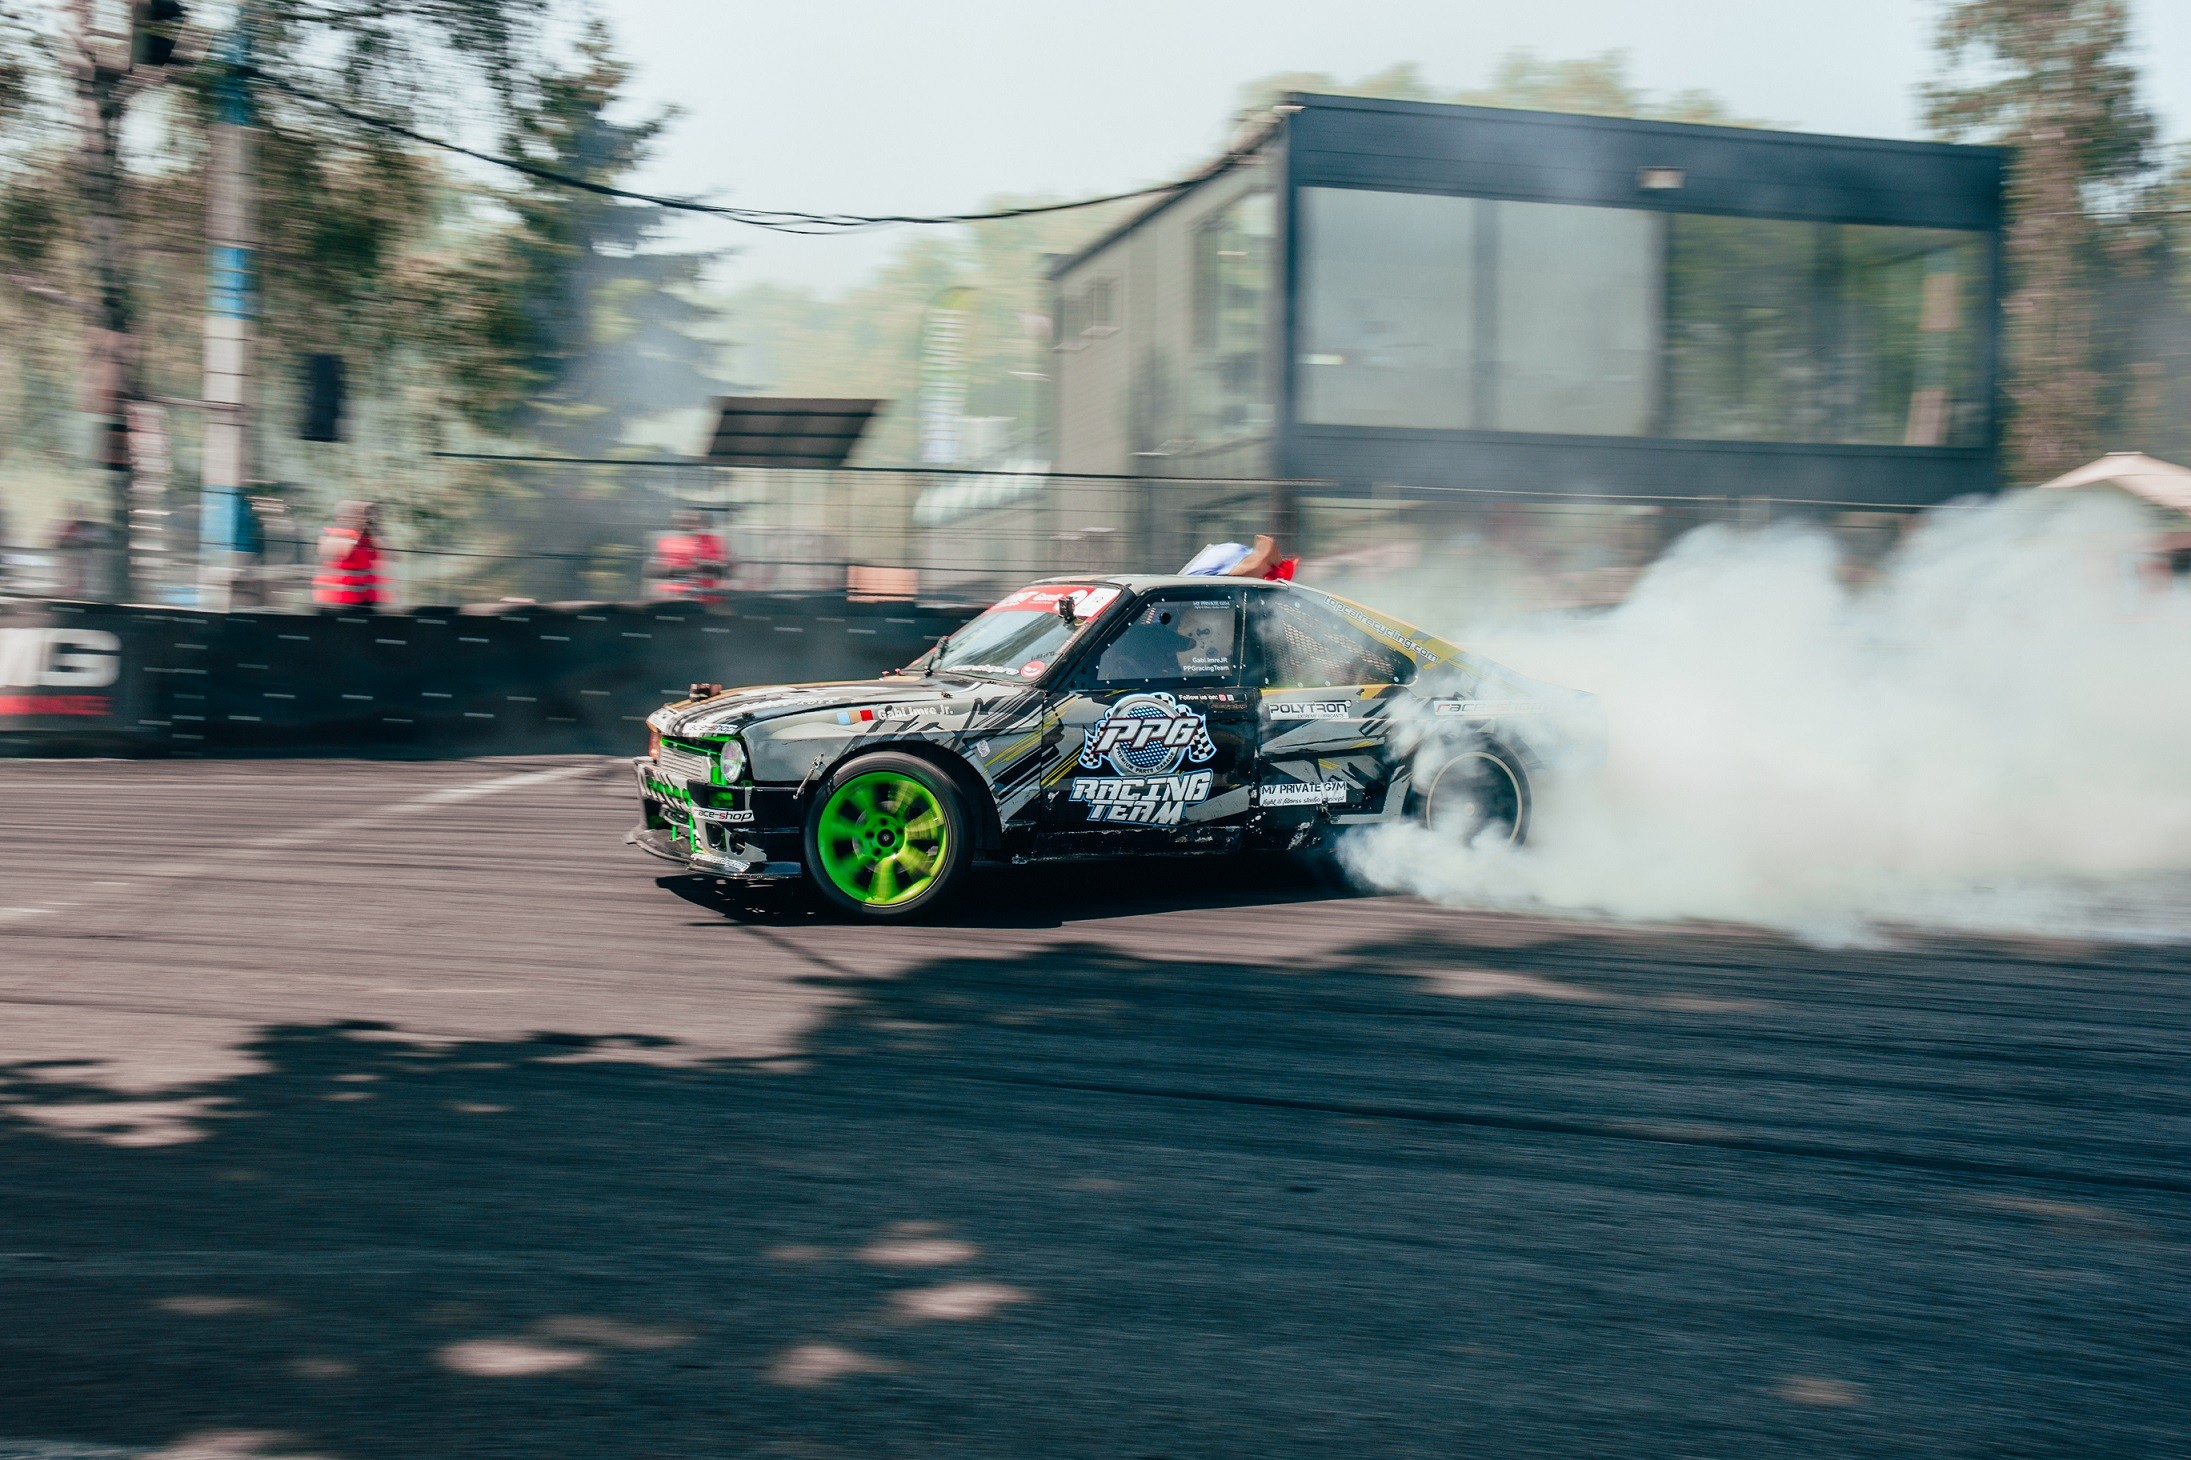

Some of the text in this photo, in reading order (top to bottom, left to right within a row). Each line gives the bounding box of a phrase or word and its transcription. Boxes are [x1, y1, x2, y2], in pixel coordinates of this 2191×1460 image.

[1324, 595, 1439, 664] topcatrecycling.com
[939, 704, 954, 715] Jr.
[1094, 717, 1200, 753] PPG
[1115, 746, 1134, 770] PREMIUM
[1155, 751, 1175, 771] GARAGE
[1071, 770, 1212, 802] RACING
[1280, 783, 1321, 794] PRIVATE
[1324, 782, 1346, 792] GYM
[1089, 800, 1185, 825] TEAM
